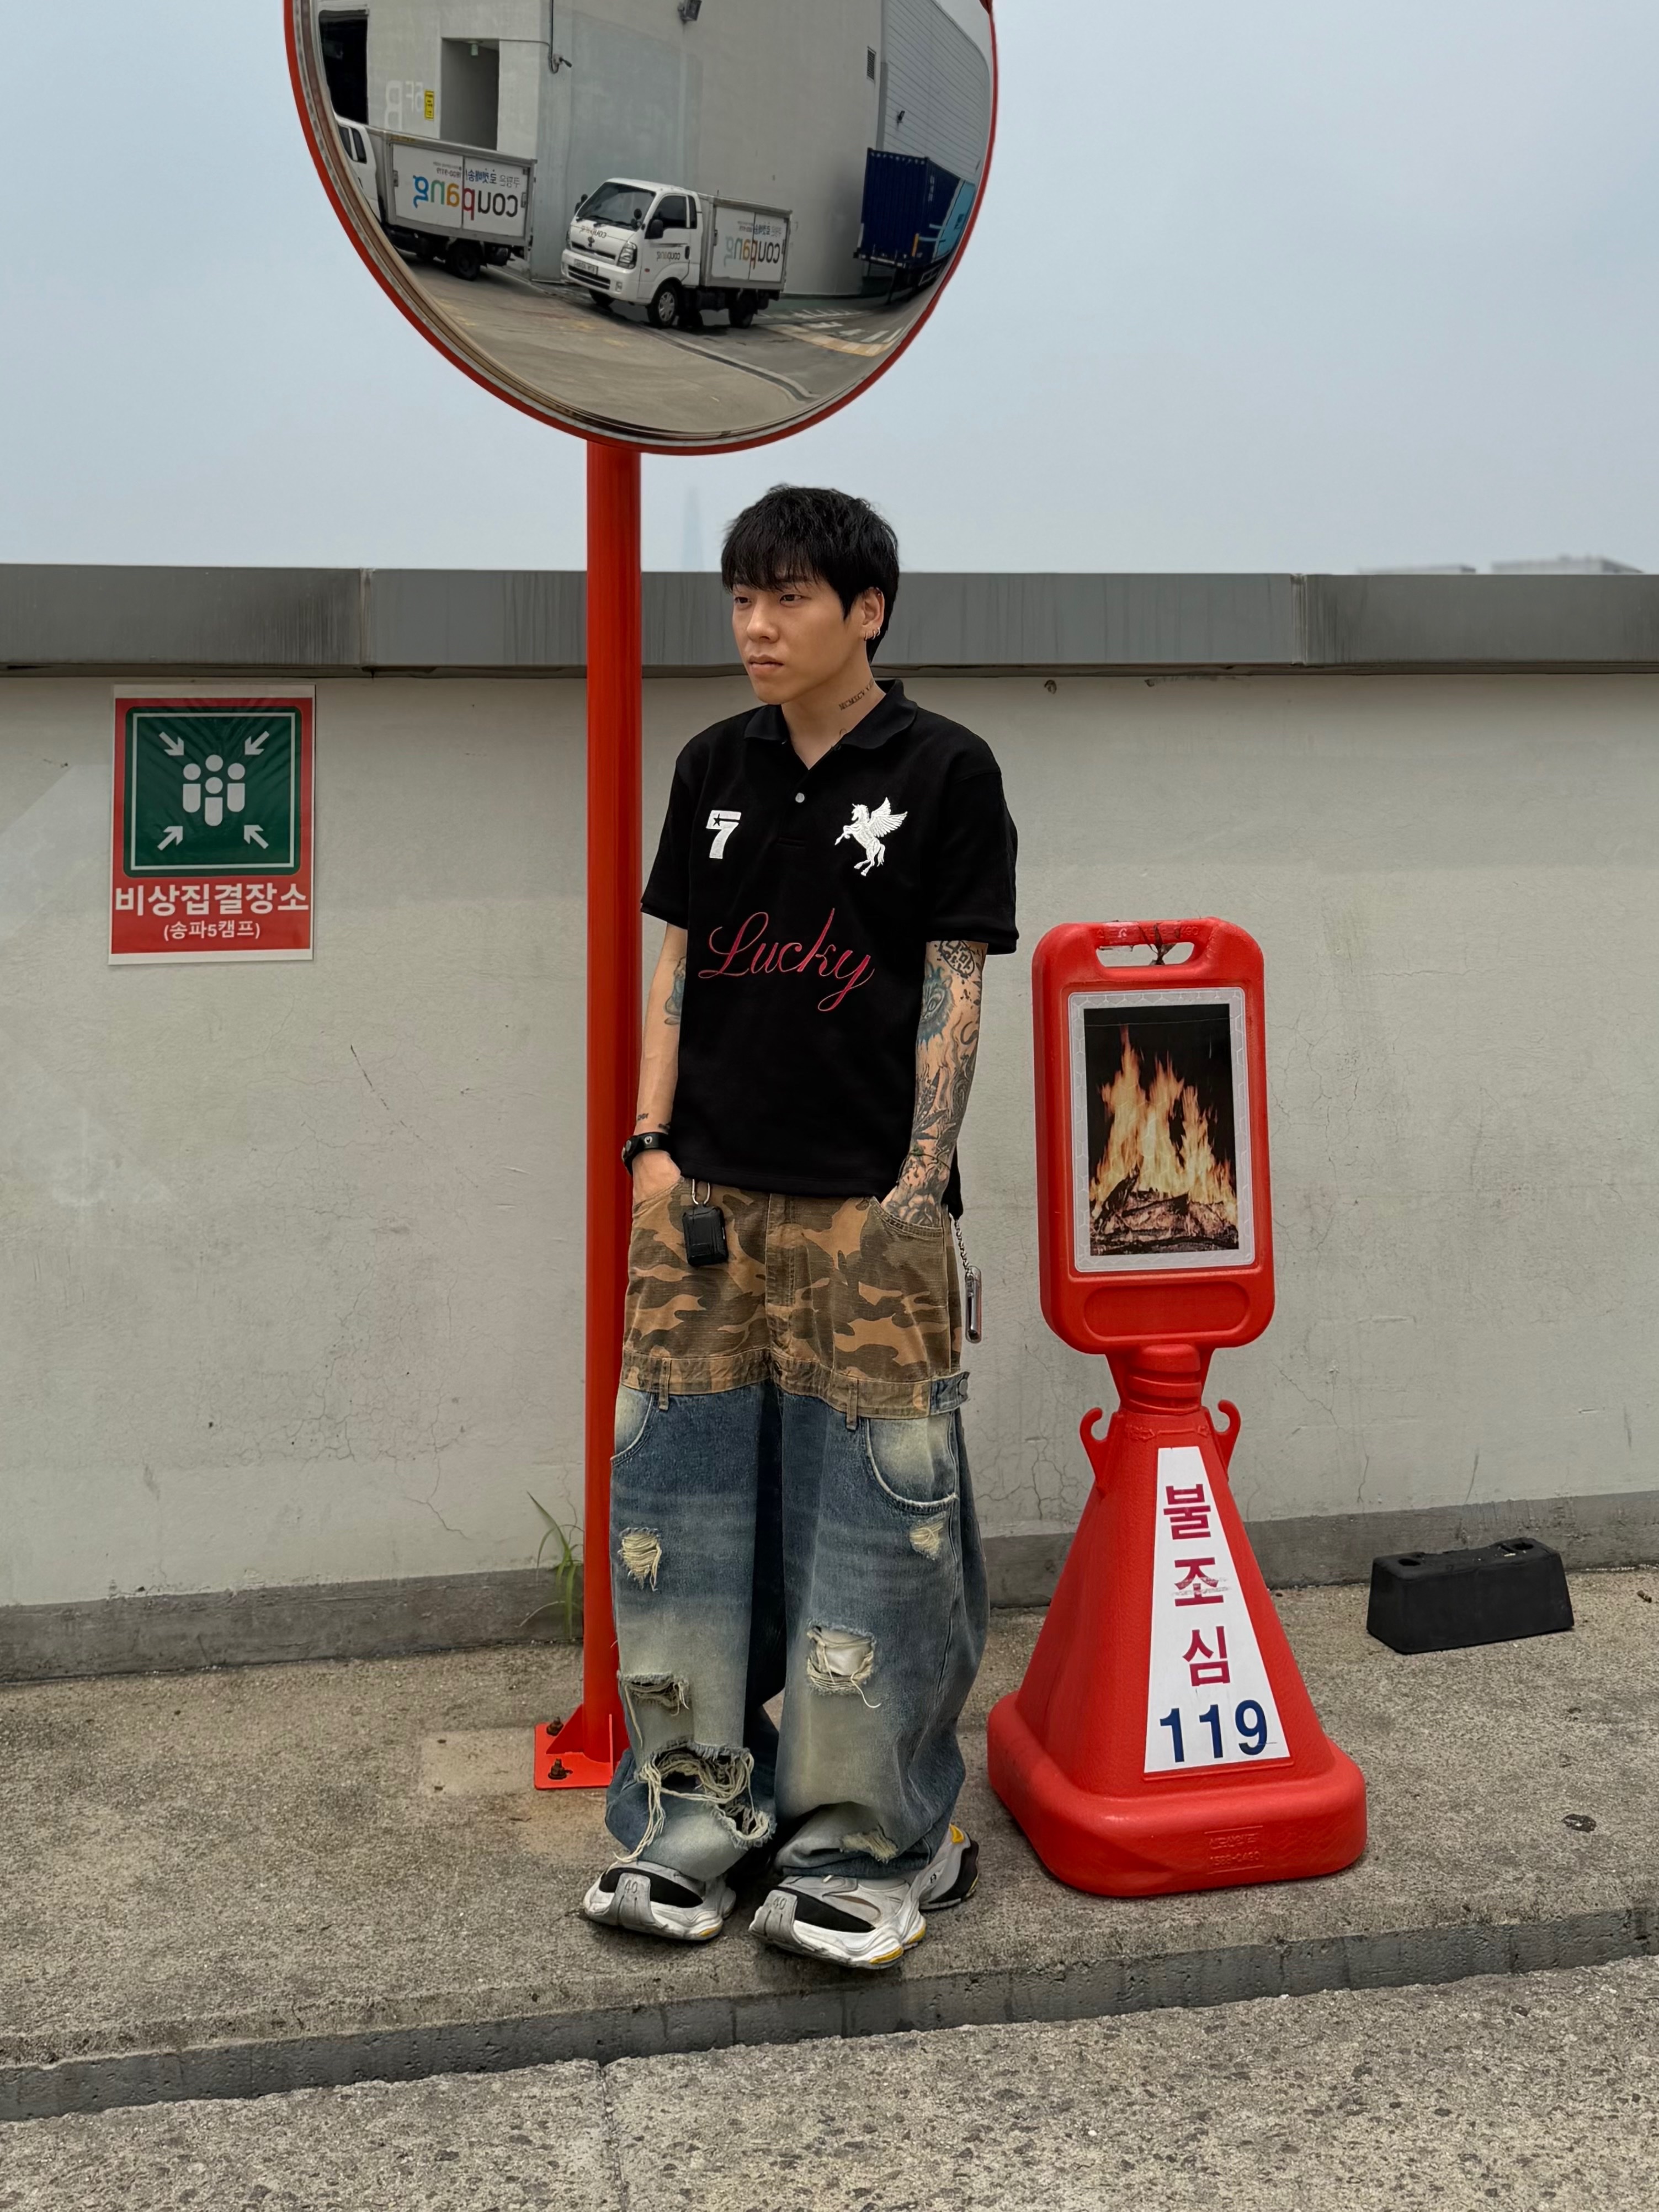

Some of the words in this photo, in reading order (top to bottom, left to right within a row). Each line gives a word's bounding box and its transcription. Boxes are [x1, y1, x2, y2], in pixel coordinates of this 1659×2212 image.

[706, 810, 742, 859] 7
[115, 882, 310, 916] 비상집결장소
[163, 919, 260, 940] (송파5캠프)
[698, 908, 875, 1012] Lucky
[1160, 1699, 1268, 1763] 119
[624, 1879, 638, 1894] 40
